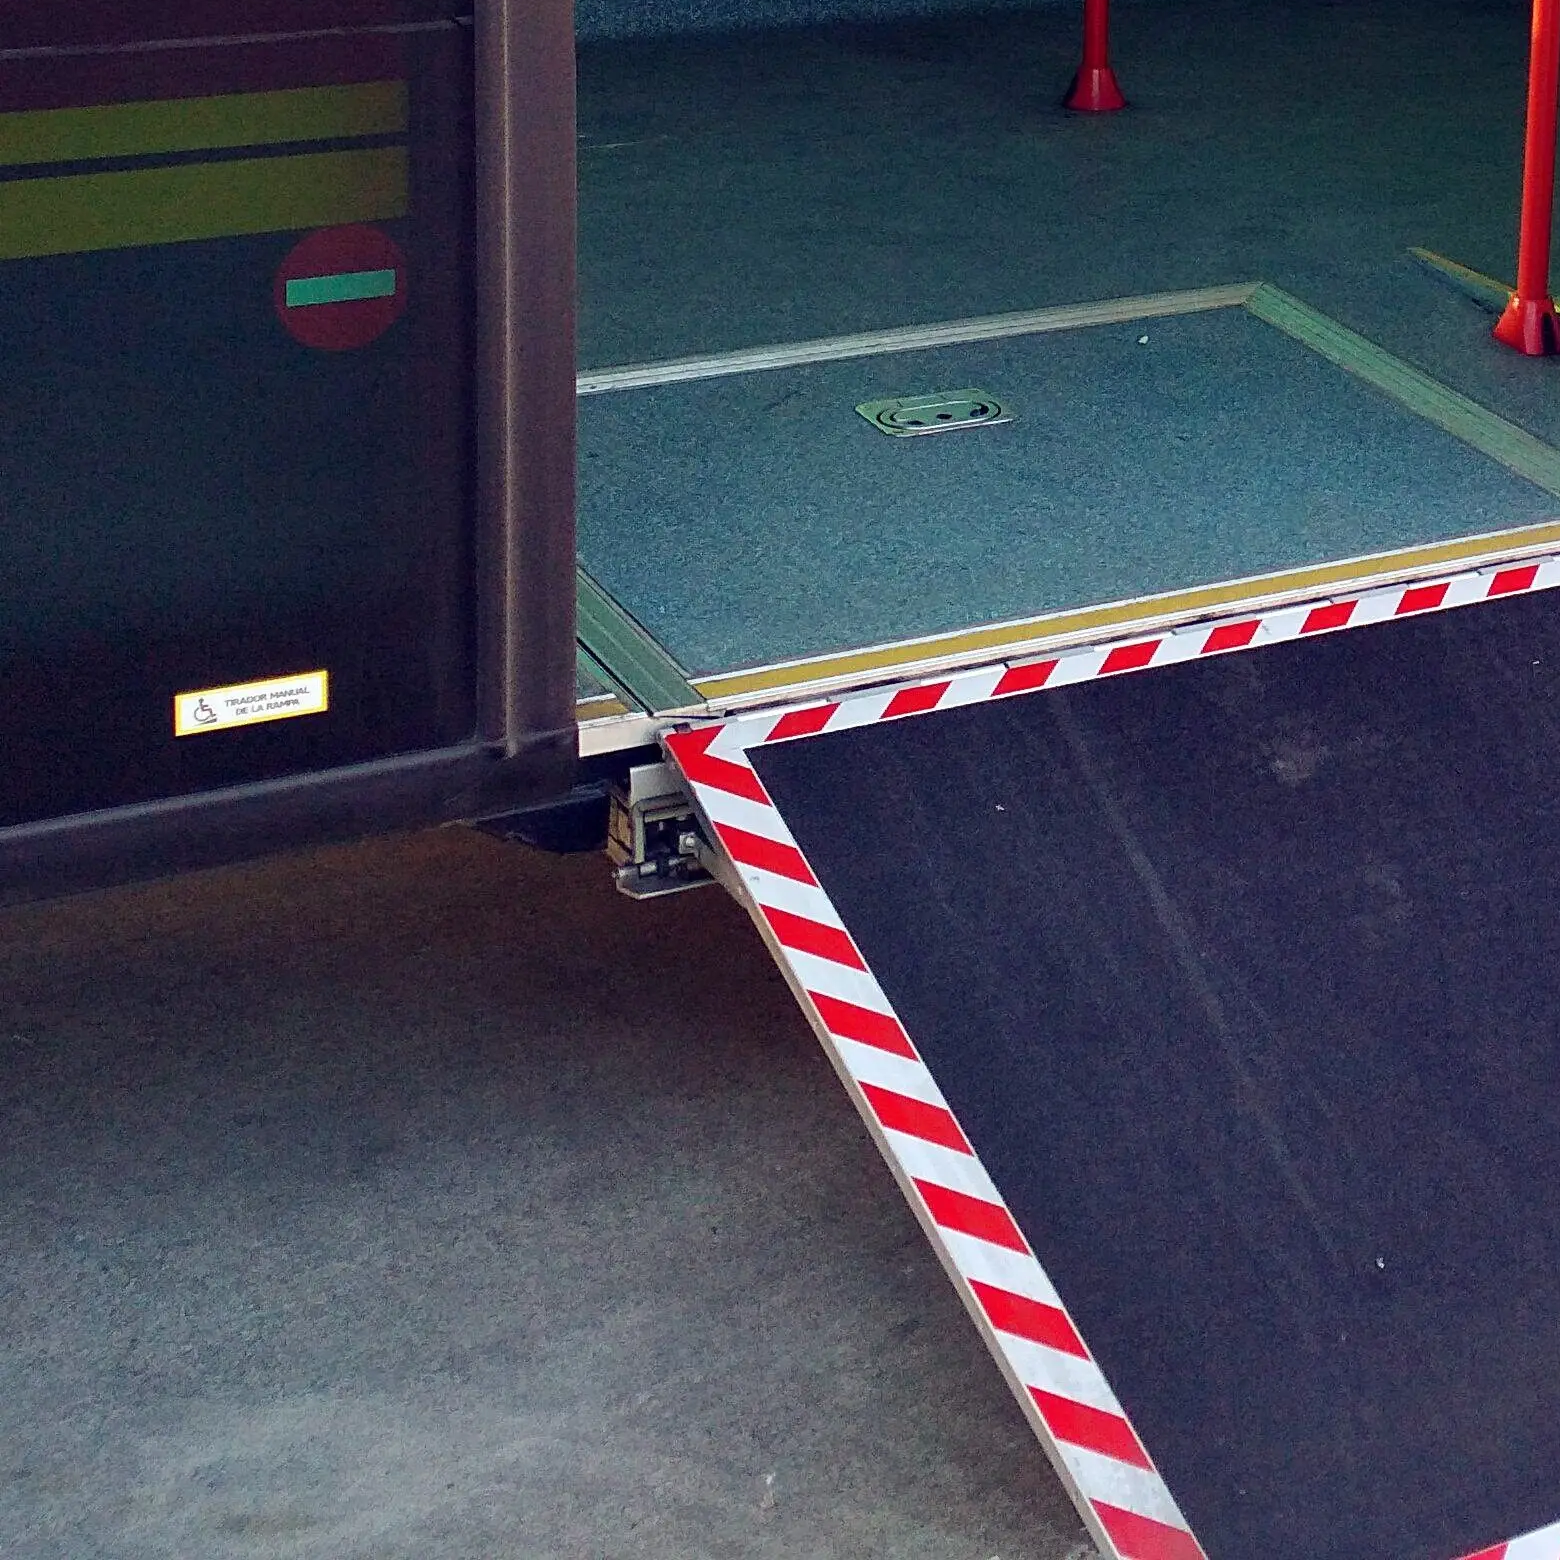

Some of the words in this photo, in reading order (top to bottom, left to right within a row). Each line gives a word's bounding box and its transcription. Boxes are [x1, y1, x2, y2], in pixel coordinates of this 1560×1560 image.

[224, 693, 268, 708] TIRADOR
[269, 686, 310, 701] MANUAL
[235, 706, 249, 716] DE
[251, 704, 264, 713] LA
[266, 698, 301, 711] RAMPA
